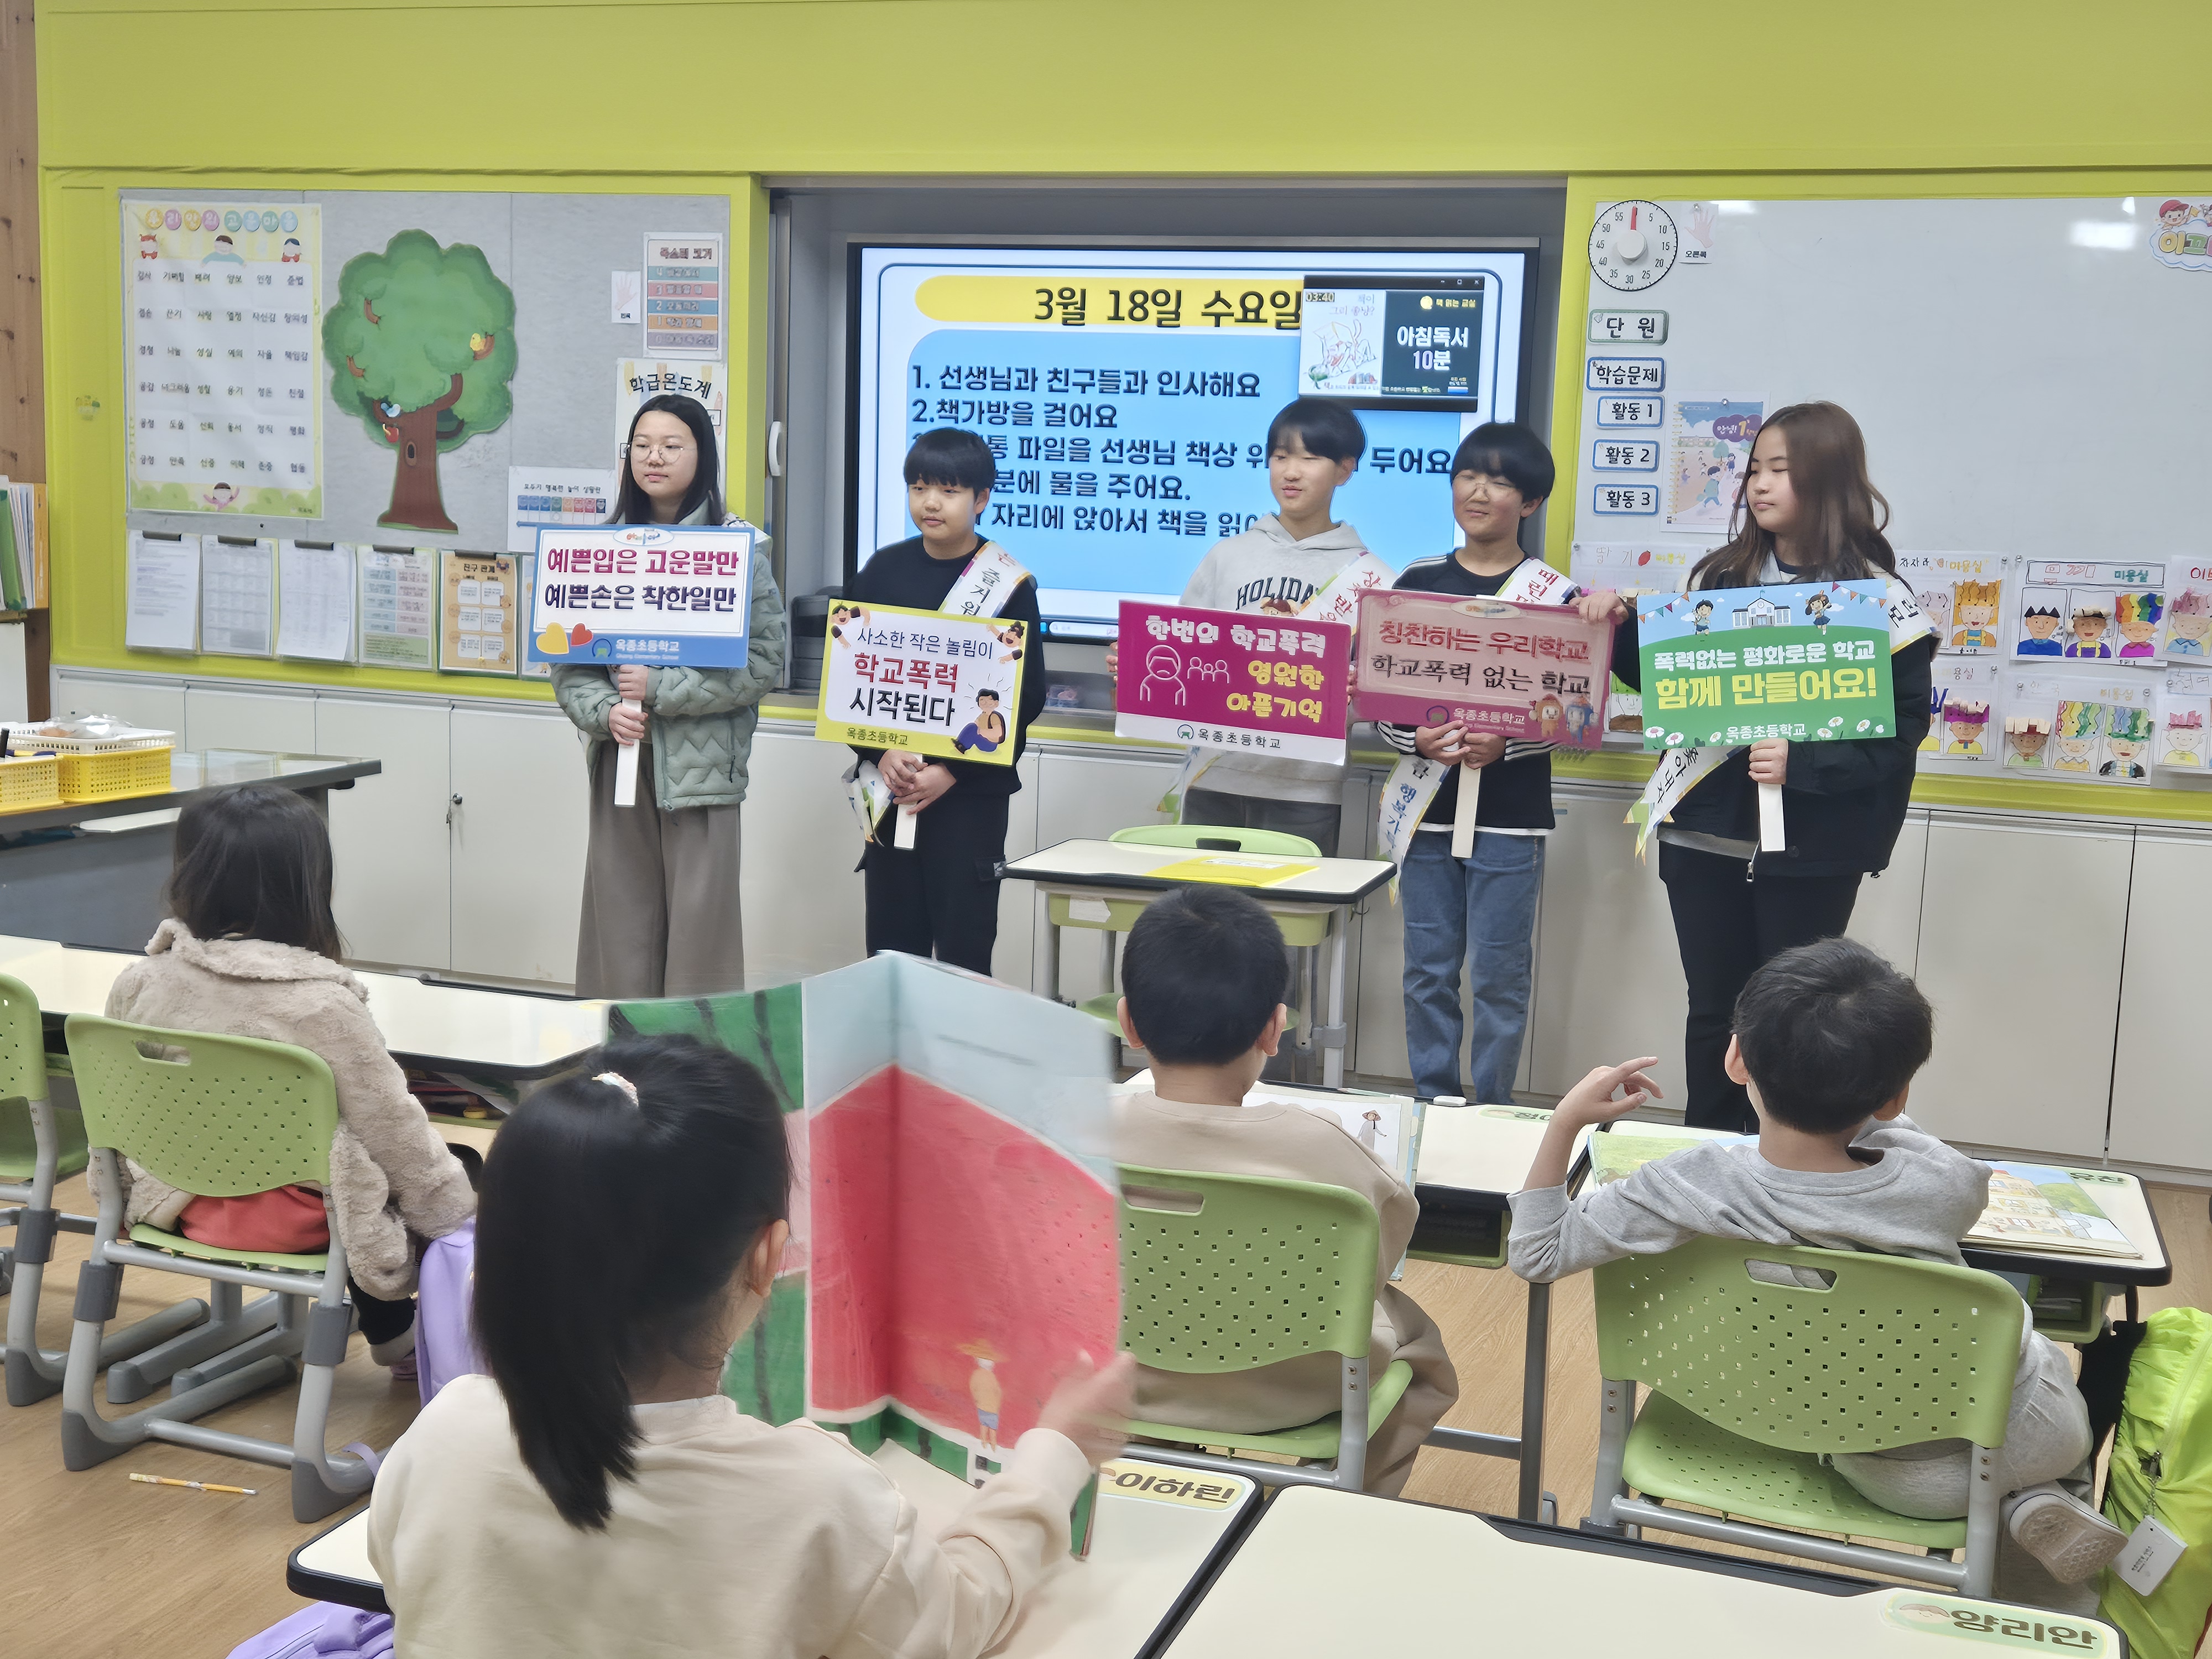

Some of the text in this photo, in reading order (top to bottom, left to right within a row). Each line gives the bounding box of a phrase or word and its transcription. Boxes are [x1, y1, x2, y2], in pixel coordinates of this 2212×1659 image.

[1602, 224, 1610, 233] 50
[1615, 212, 1623, 221] 55
[1649, 213, 1653, 222] 5
[1660, 225, 1667, 234] 10
[1596, 240, 1604, 249] 45
[1662, 242, 1670, 251] 15
[1599, 257, 1607, 266] 40
[1610, 269, 1618, 278] 35
[1642, 270, 1651, 279] 25
[1655, 259, 1664, 268] 20
[1625, 275, 1634, 284] 30
[1035, 288, 1301, 330] 3월 18일 수요일
[1397, 326, 1469, 348] 아침독서
[1413, 350, 1451, 371] 10분
[629, 373, 712, 399] 학급온도계
[912, 365, 1261, 398] 1. 선생님과 친구들과 인사해요
[1597, 365, 1658, 385] 학습문제
[1044, 402, 1118, 429] 걸어요
[1611, 402, 1653, 421] 활동 1
[1018, 436, 1091, 463] 파일을
[1100, 439, 1176, 466] 선생님
[1186, 441, 1237, 467] 책상
[1370, 447, 1452, 474] 두어요
[1606, 446, 1650, 465] 활동 2
[1050, 471, 1098, 497] 물을
[1108, 473, 1190, 500] 주어요.
[1606, 490, 1651, 508] 활동 3
[992, 504, 1064, 529] 자리에
[1073, 506, 1147, 533] 앉아서
[1157, 509, 1207, 536] 책을
[547, 548, 739, 576] 예쁜입은 고운말만
[2114, 570, 2149, 583] 미용실
[545, 583, 737, 613] 예쁜손은 착한일만
[1235, 577, 1318, 611] HOLIDA
[857, 628, 993, 660] 사소한 작은 놀림이
[1145, 615, 1326, 659] 한번의 학교폭력
[1379, 619, 1590, 664] 칭찬하는 우리학교
[1654, 639, 1876, 672] 폭력없는 평화로운 학교
[854, 652, 959, 693] 학교폭력
[1248, 660, 1324, 691] 영원한
[1371, 654, 1590, 696] 학교폭력 없는 학교
[1656, 667, 1877, 710] 함께 만들어요!
[849, 687, 956, 727] 시작된다
[1226, 691, 1323, 723] 아픈기억
[847, 727, 908, 746] 옥종초등학교
[1198, 728, 1281, 749] 옥종초등학교
[1725, 723, 1807, 743] 옥종초등학교
[1115, 1472, 1235, 1503] 이하린
[1951, 1610, 2098, 1650] 양리안
